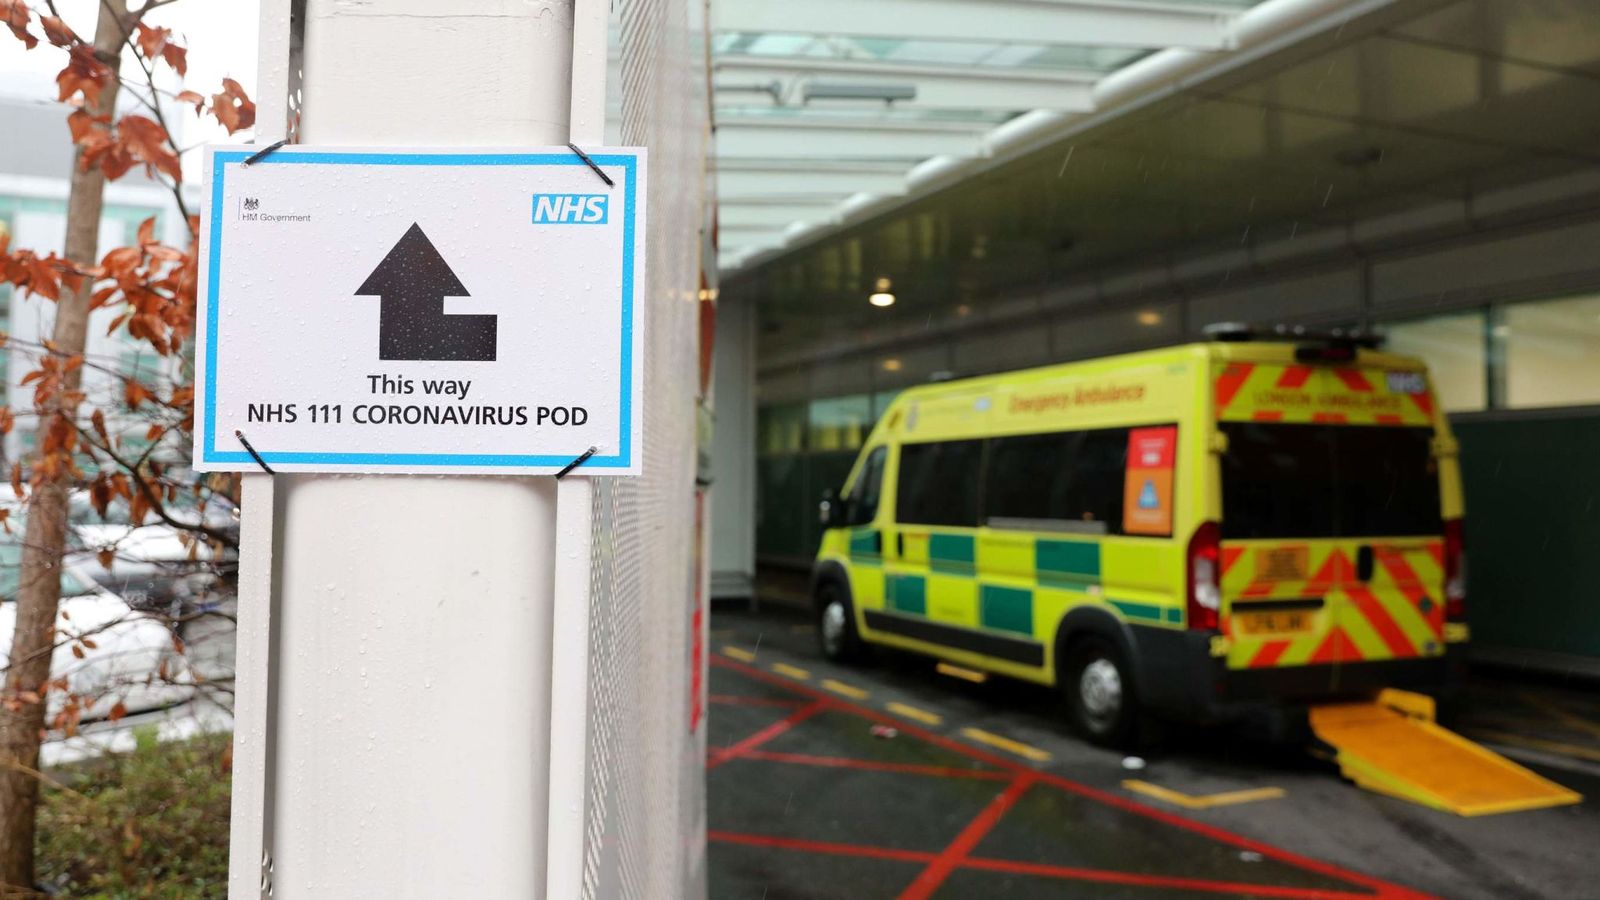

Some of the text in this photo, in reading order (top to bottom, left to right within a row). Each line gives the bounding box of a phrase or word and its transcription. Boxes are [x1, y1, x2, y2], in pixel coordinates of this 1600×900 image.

[242, 213, 311, 222] HM Government
[534, 195, 606, 223] NHS
[367, 374, 472, 400] This way
[248, 403, 588, 426] NHS 111 CORONAVIRUS POD
